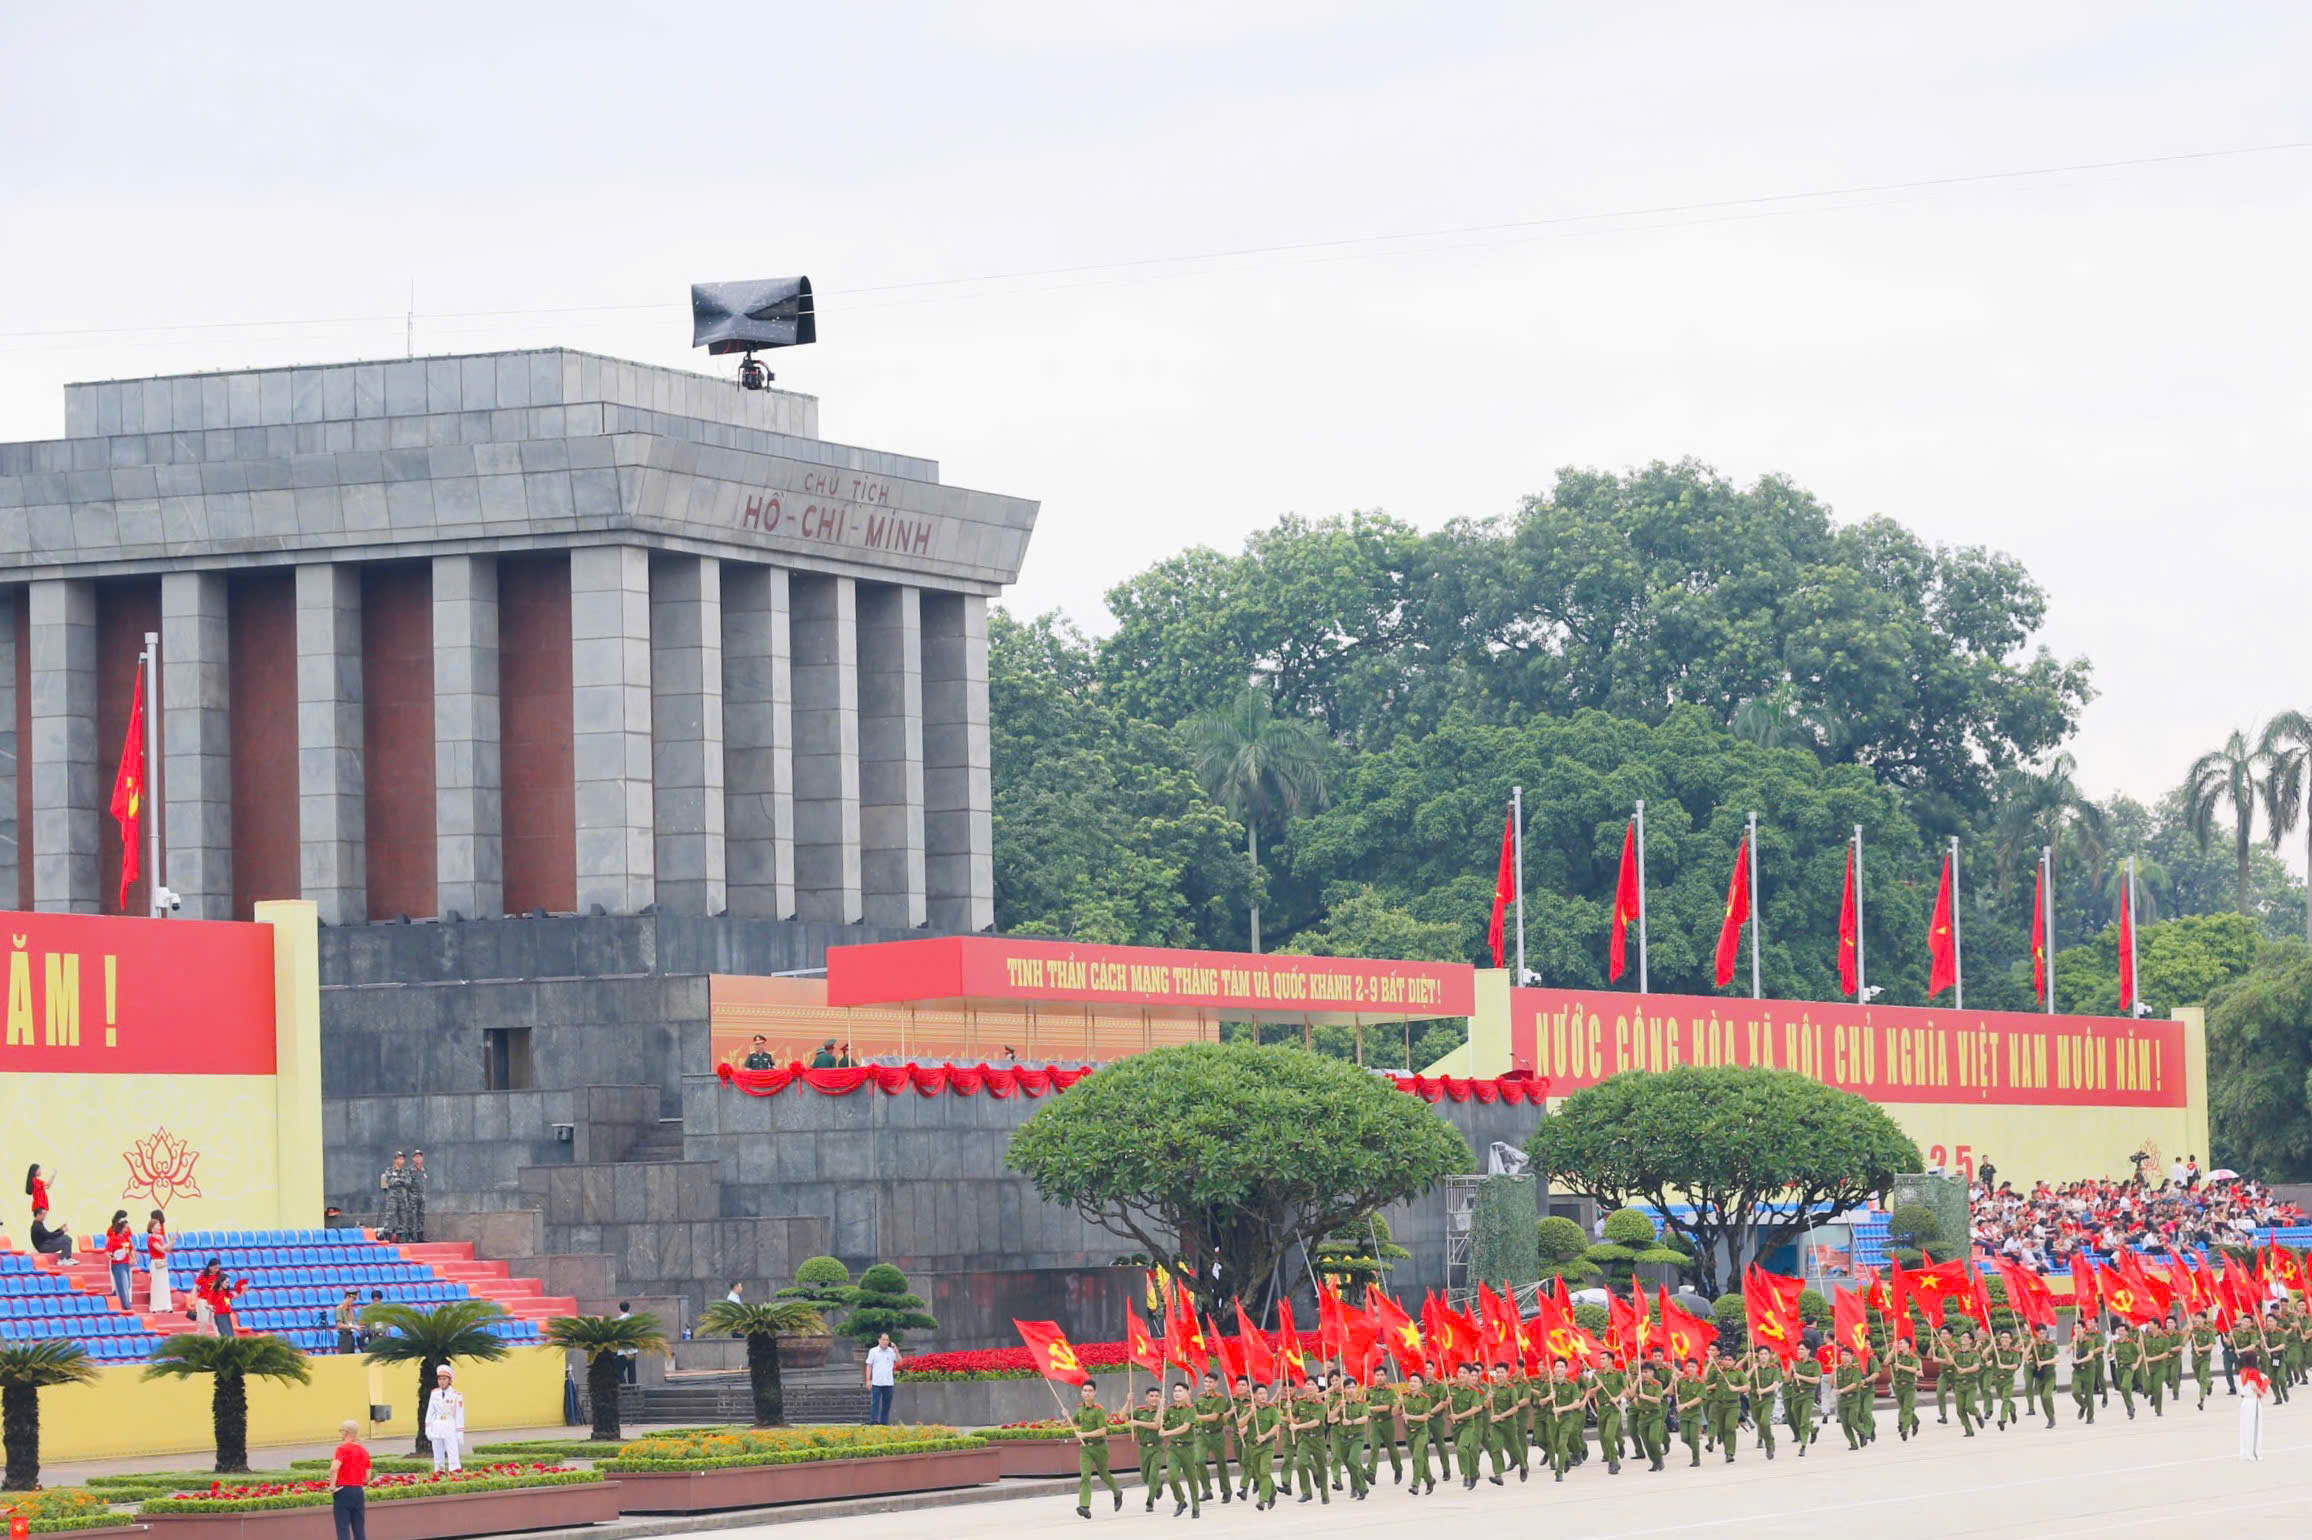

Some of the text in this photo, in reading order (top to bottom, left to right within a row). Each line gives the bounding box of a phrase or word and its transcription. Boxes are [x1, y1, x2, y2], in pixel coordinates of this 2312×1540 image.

[1007, 957, 1044, 988] TINH
[1090, 957, 1128, 993] CÁCH
[1130, 965, 1170, 998] MẠNG
[1173, 963, 1218, 997] THÁNG
[1220, 965, 1251, 998] TÁM
[1253, 966, 1272, 999] VÀ
[1273, 964, 1307, 1001] QUỐC
[1310, 969, 1353, 1002] KHÁNH
[1355, 975, 1379, 1003] 2-9
[1380, 969, 1406, 1003] BẤT
[1535, 1002, 1603, 1080] NƯỚC
[1692, 1009, 1737, 1070] HÒA
[1747, 1012, 1775, 1070] XÃ
[1834, 1012, 1876, 1086] CHỦ
[1886, 1021, 1949, 1087] NGHĨA
[1957, 1022, 2001, 1099] VIỆT
[2008, 1032, 2048, 1089] NAM
[2056, 1026, 2107, 1090] MUÔN
